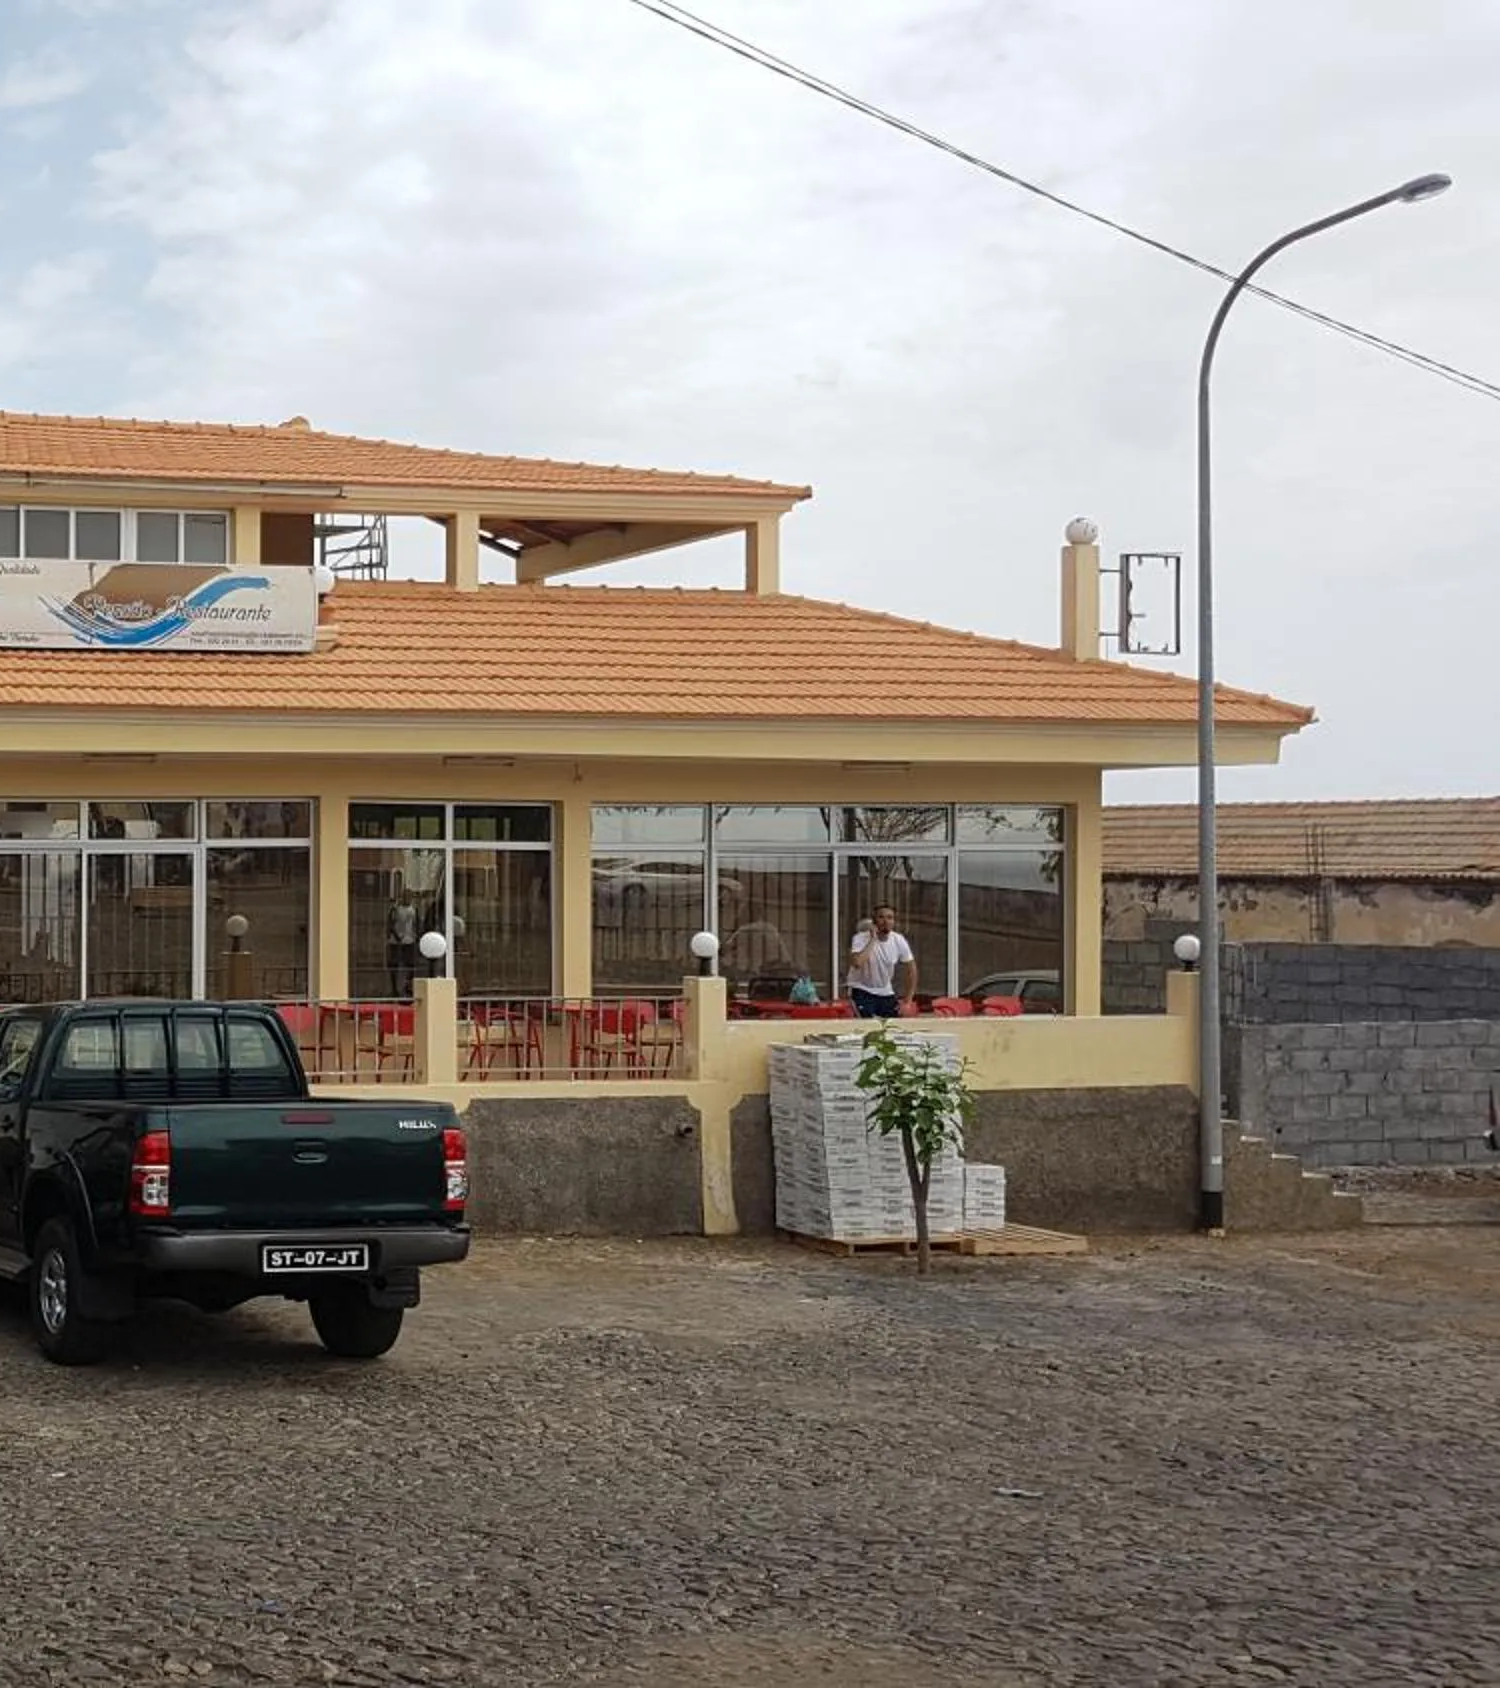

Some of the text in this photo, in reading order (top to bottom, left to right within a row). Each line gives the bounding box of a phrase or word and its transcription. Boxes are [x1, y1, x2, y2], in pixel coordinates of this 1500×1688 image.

[165, 595, 273, 622] Restaurante
[399, 1120, 437, 1130] HILUX
[271, 1251, 360, 1265] ST-07-JT
